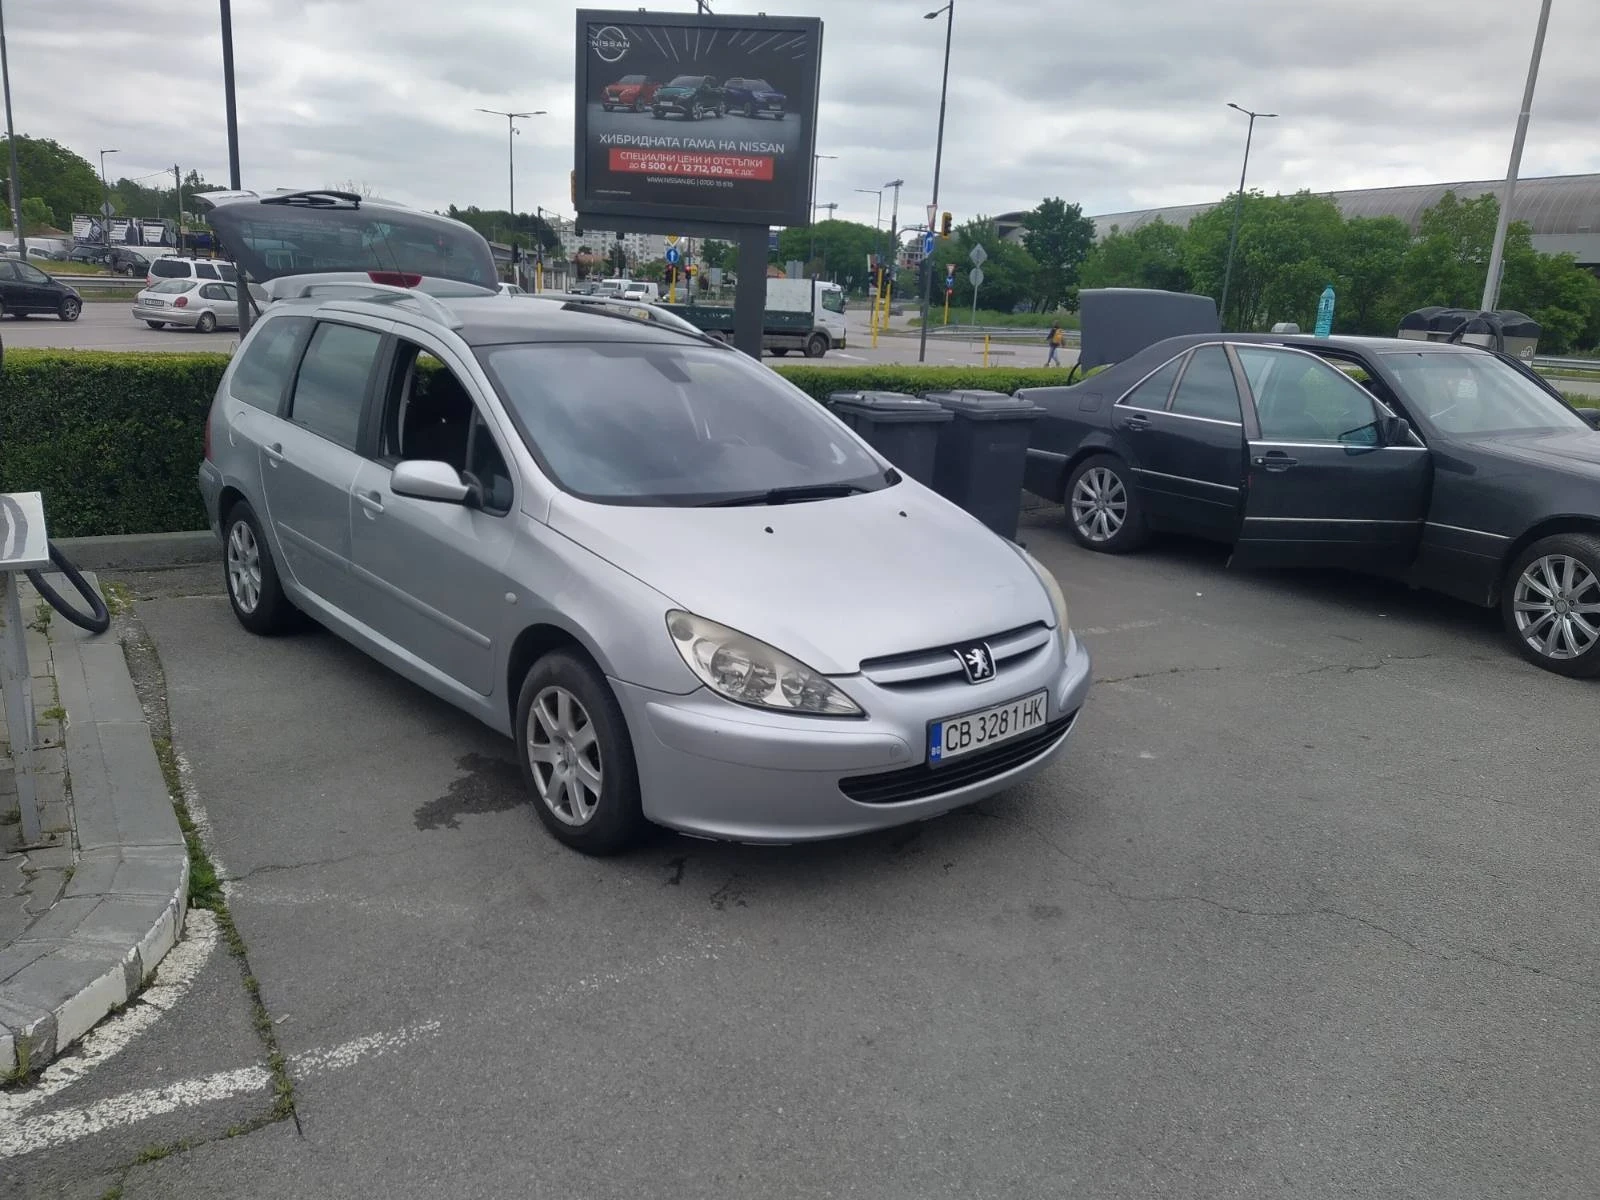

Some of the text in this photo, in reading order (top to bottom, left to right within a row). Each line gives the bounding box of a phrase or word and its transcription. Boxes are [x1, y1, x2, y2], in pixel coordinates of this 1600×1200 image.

[591, 39, 630, 48] NISSAN
[600, 134, 784, 153] ХИБРИДНАТА ГАМА НА NISSAN
[620, 151, 763, 167] СПЕЦИАЛНИ ЦЕНИ И ОТСТЪПКИ
[640, 161, 647, 169] 6
[647, 162, 666, 170] 500
[682, 164, 692, 172] 12
[946, 697, 1043, 751] CB 3281 HK
